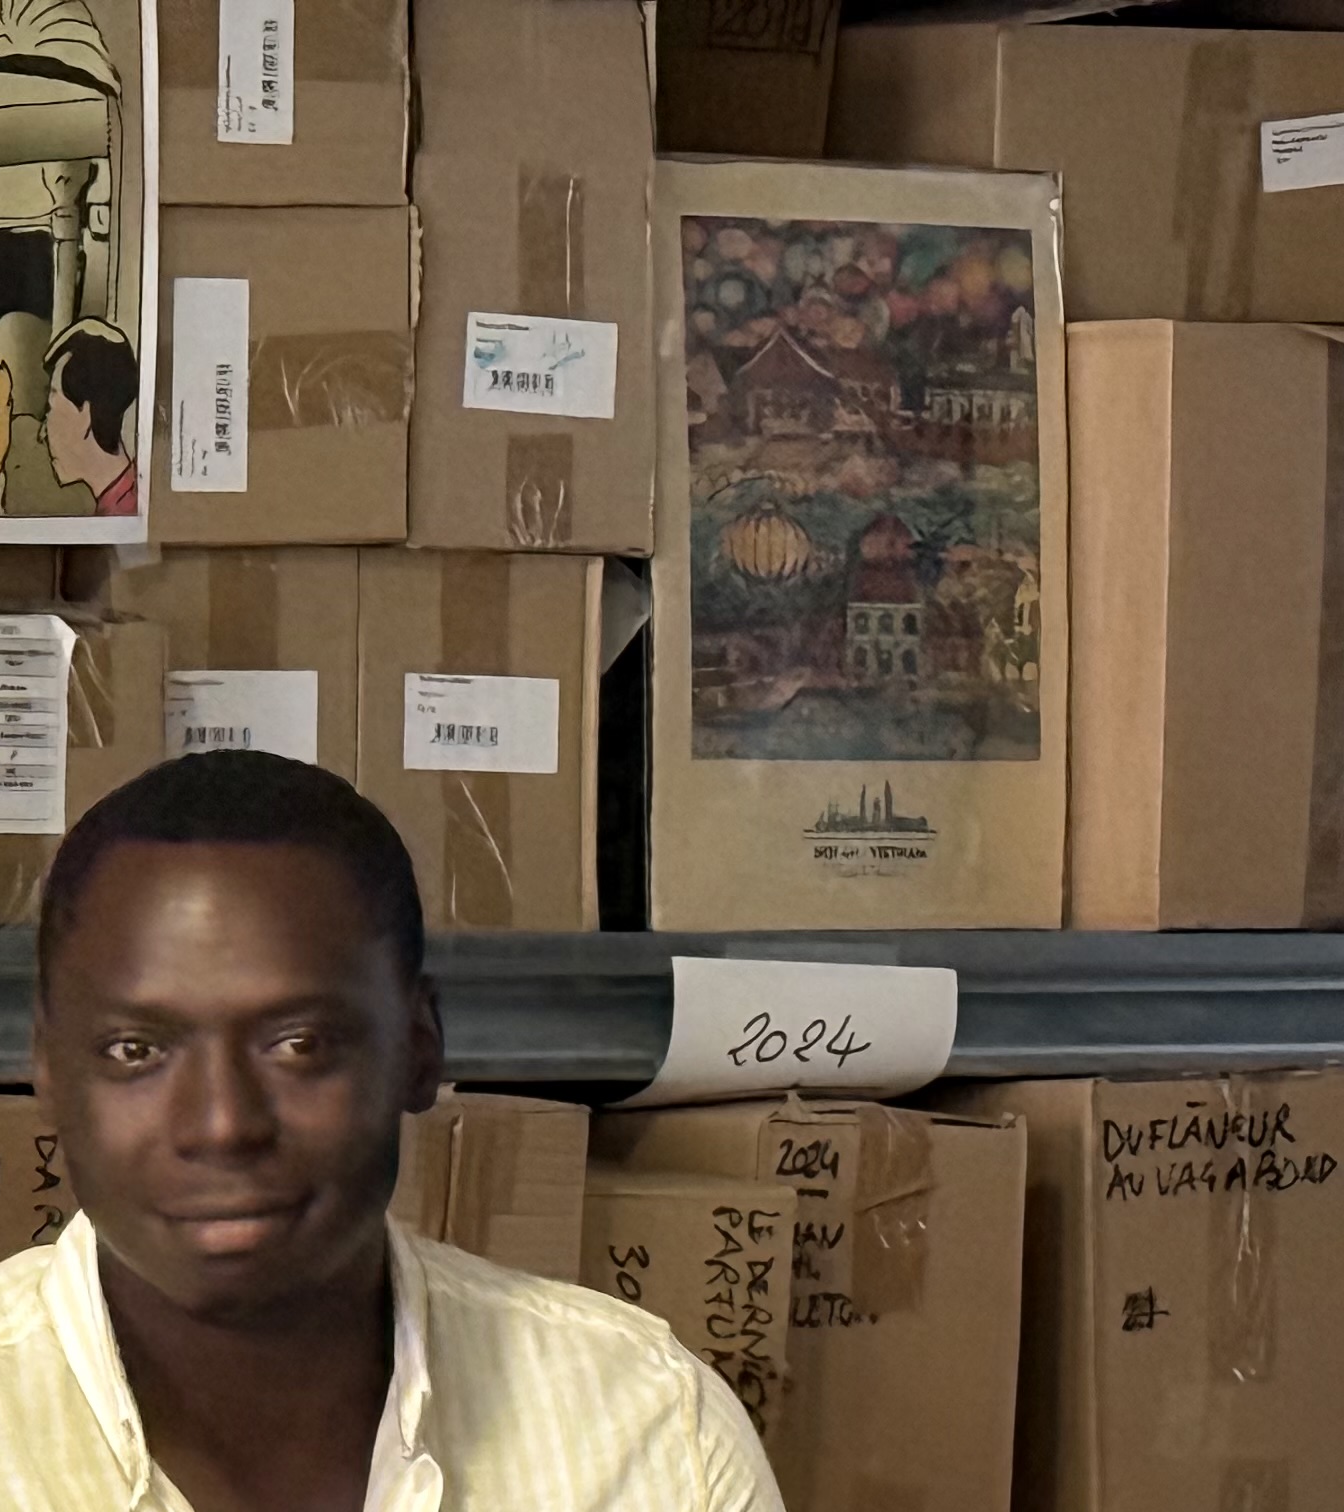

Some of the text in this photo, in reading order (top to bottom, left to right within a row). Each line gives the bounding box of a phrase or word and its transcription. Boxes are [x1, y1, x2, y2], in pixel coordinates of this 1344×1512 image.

[728, 1012, 870, 1067] 2024
[1106, 1164, 1144, 1201] AU
[608, 1245, 650, 1301] 30
